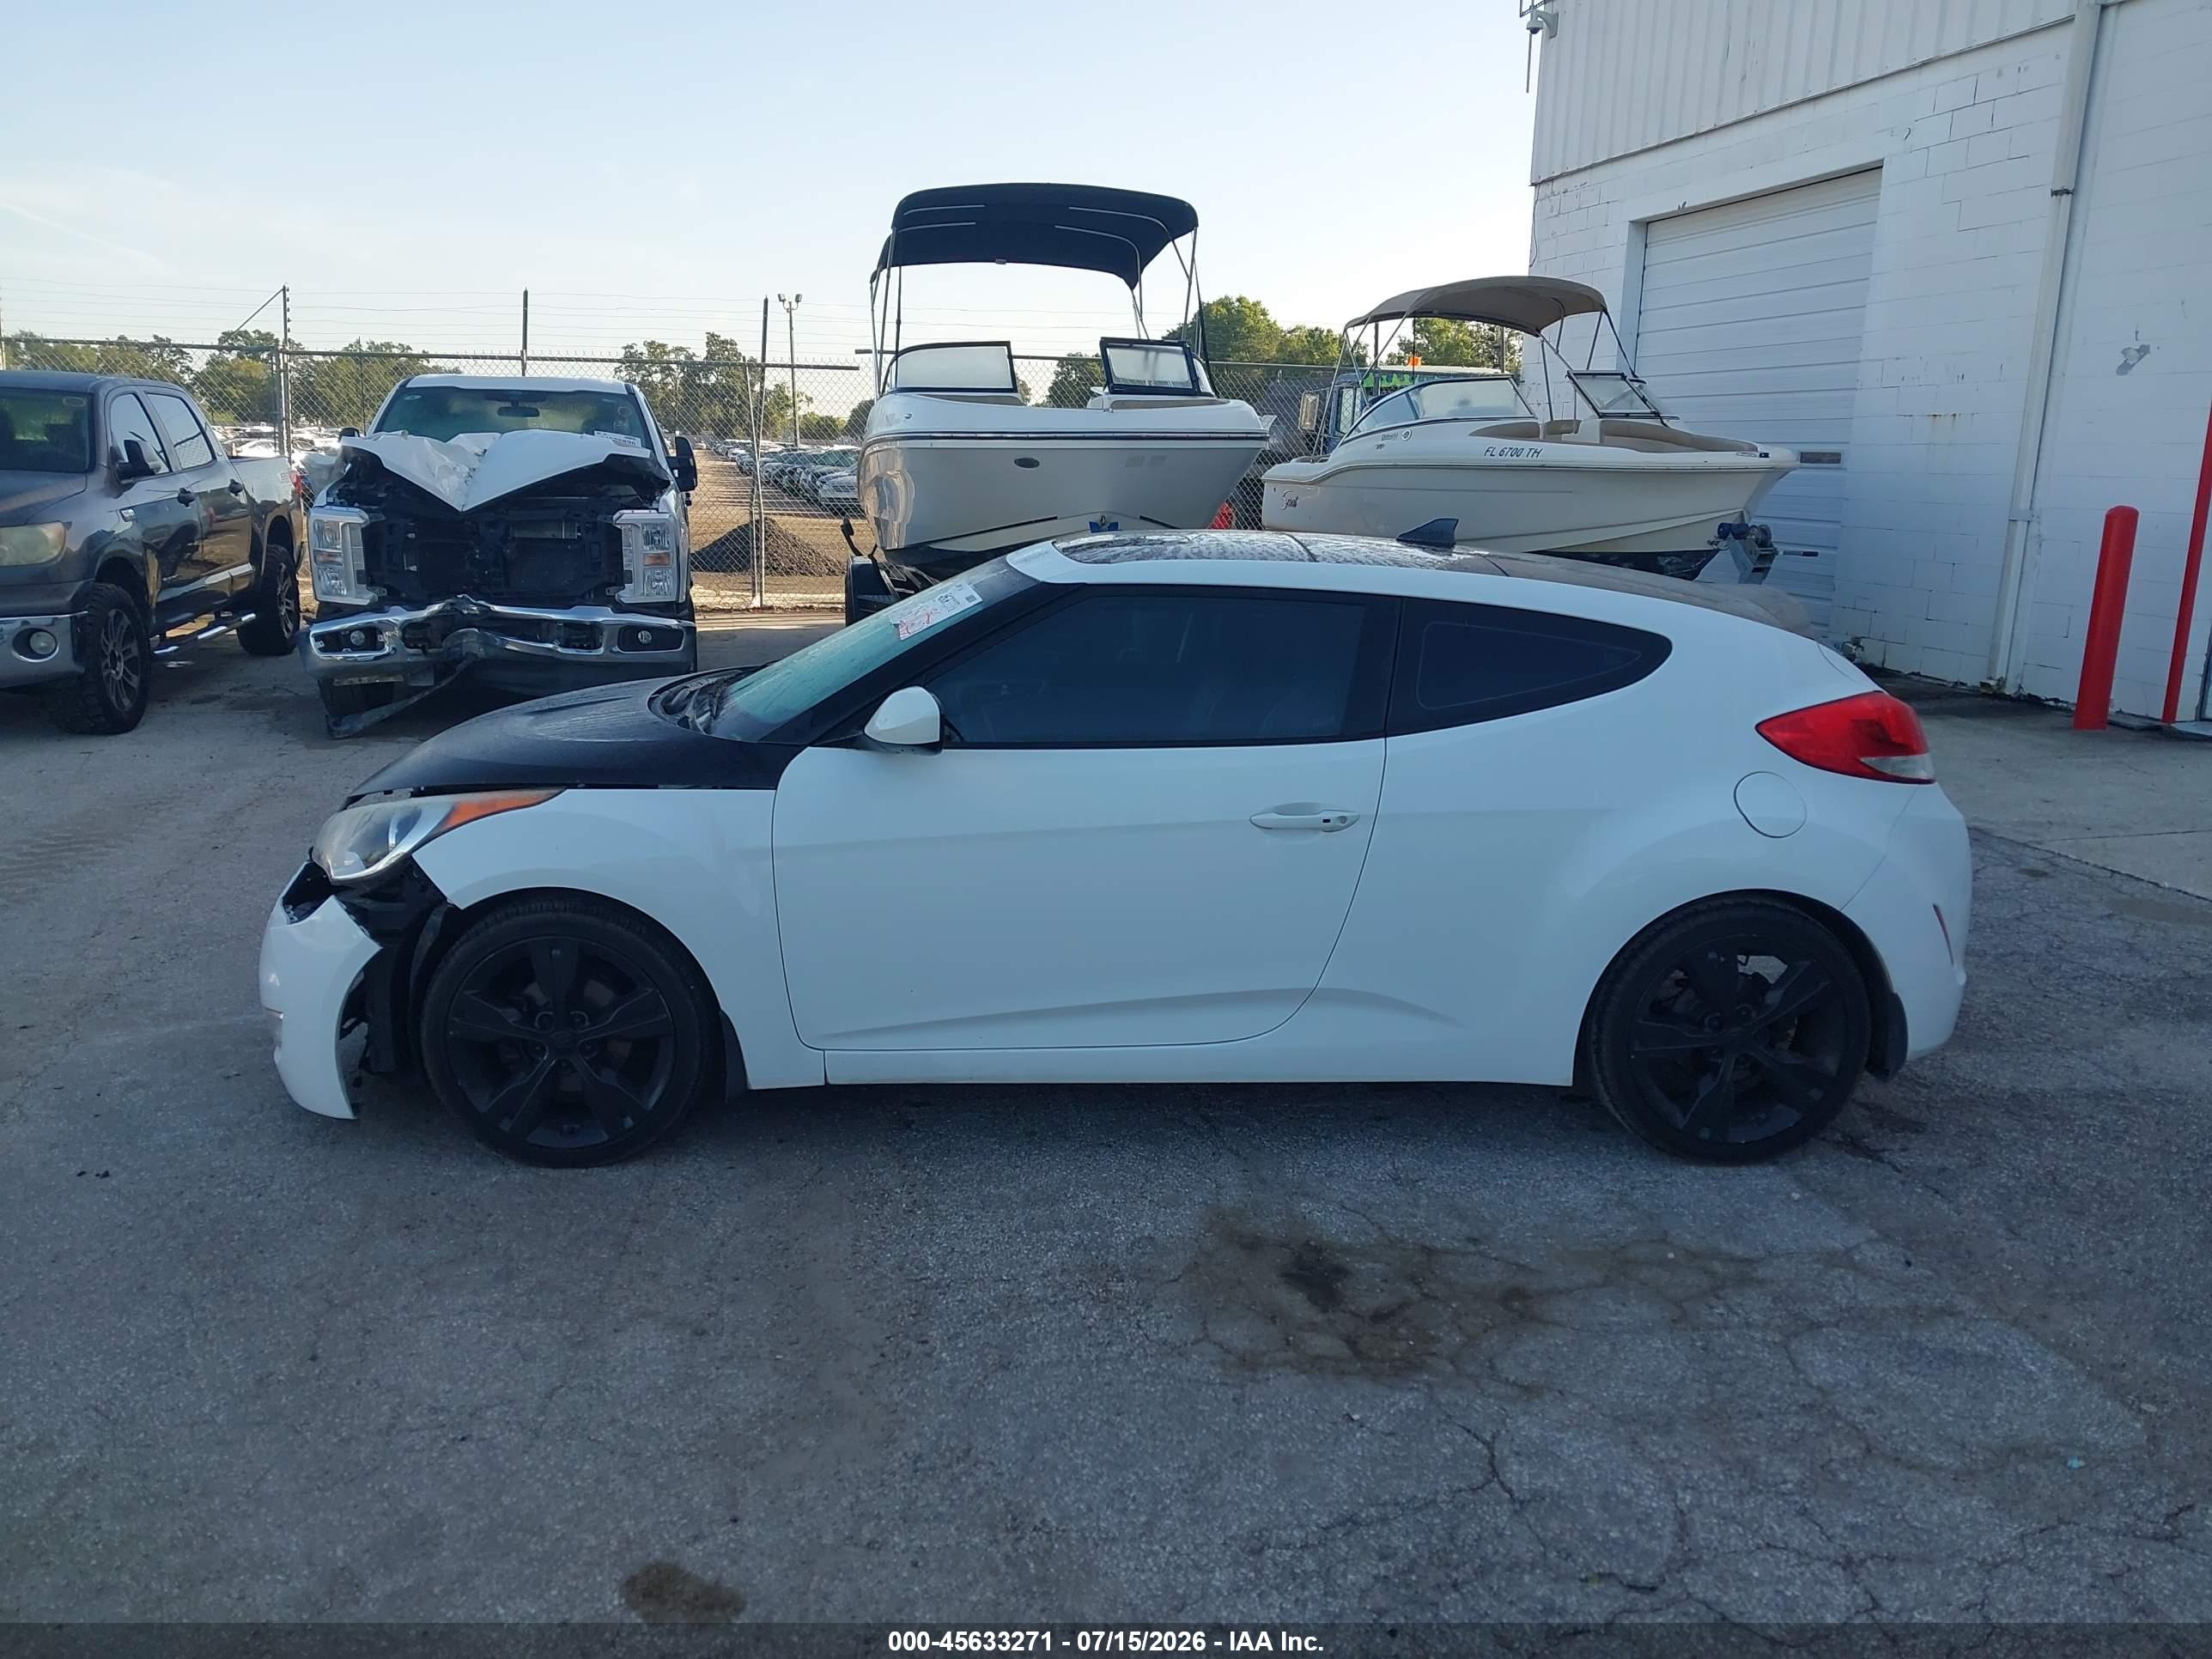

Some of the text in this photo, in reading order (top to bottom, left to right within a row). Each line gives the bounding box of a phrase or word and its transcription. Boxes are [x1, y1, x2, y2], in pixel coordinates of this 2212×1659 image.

[1484, 446, 1543, 459] FL 6700 TH
